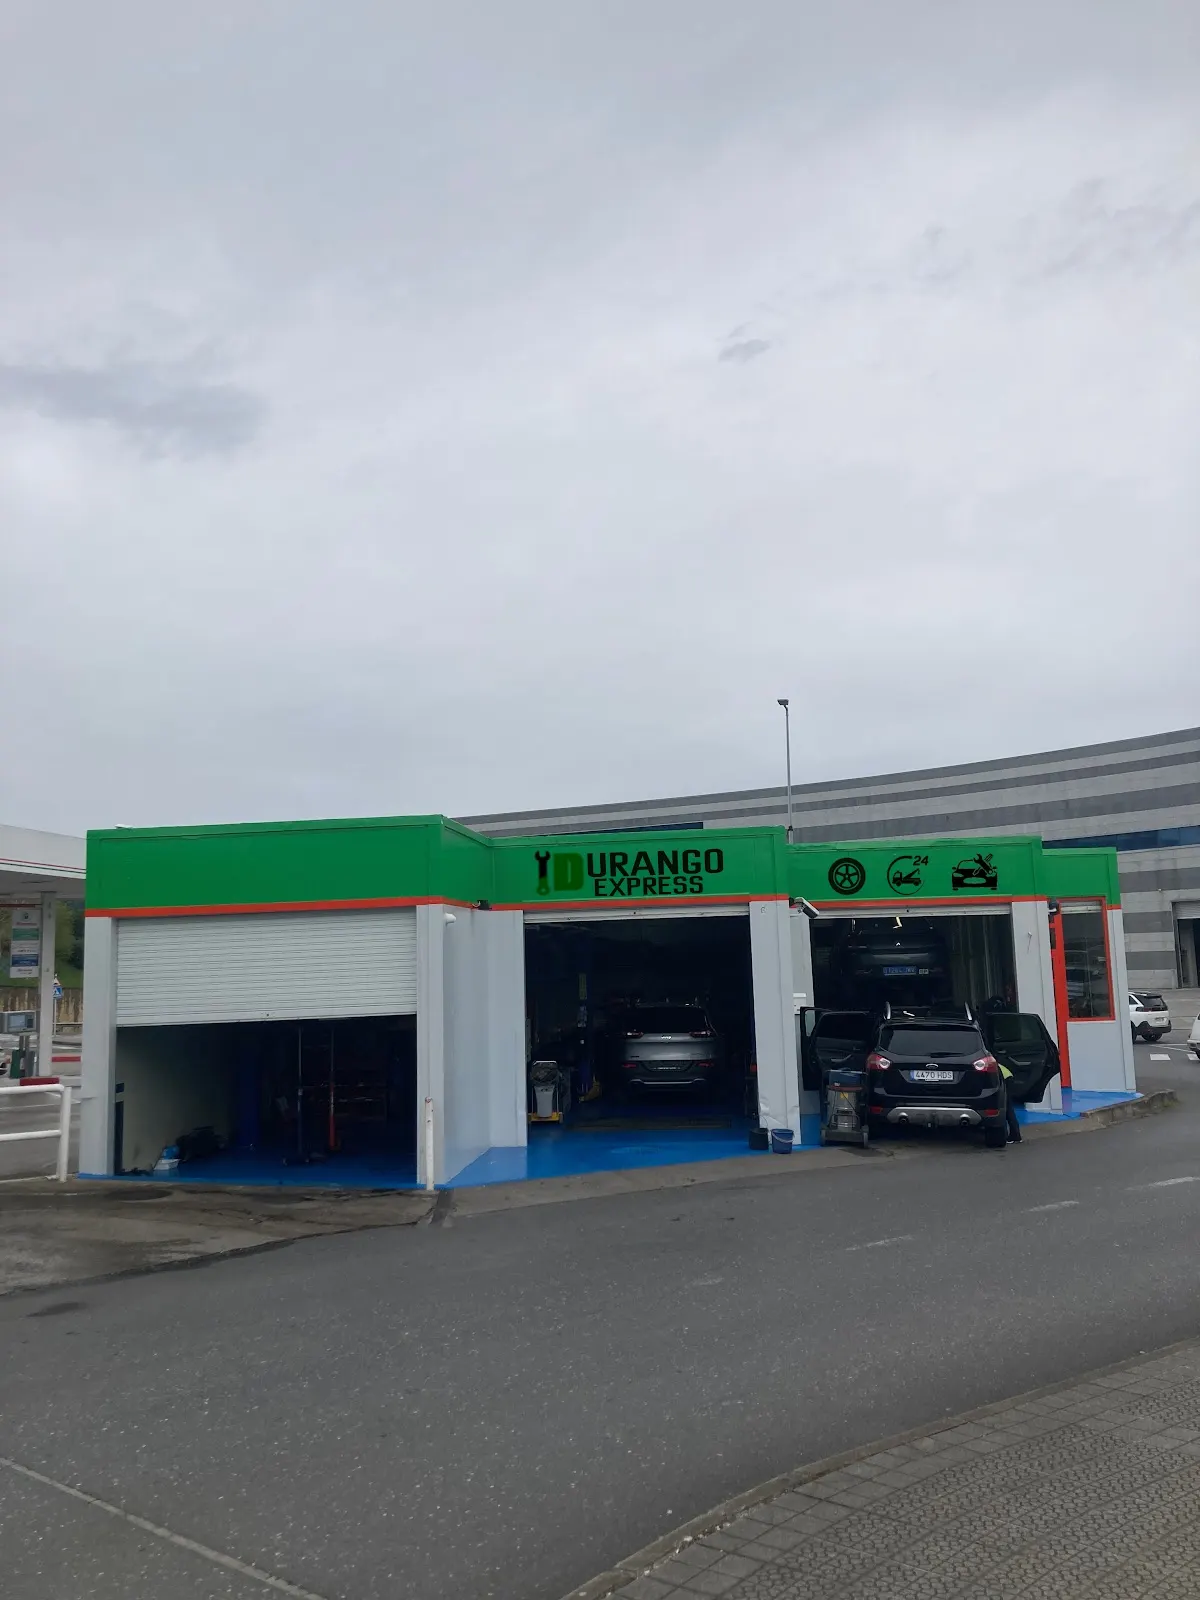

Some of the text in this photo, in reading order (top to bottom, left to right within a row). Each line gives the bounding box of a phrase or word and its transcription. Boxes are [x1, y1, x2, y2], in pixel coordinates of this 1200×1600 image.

[912, 855, 929, 866] 24
[553, 848, 724, 892] DURANGO
[594, 875, 704, 897] EXPRESS
[915, 1071, 953, 1079] 4470 HDS
